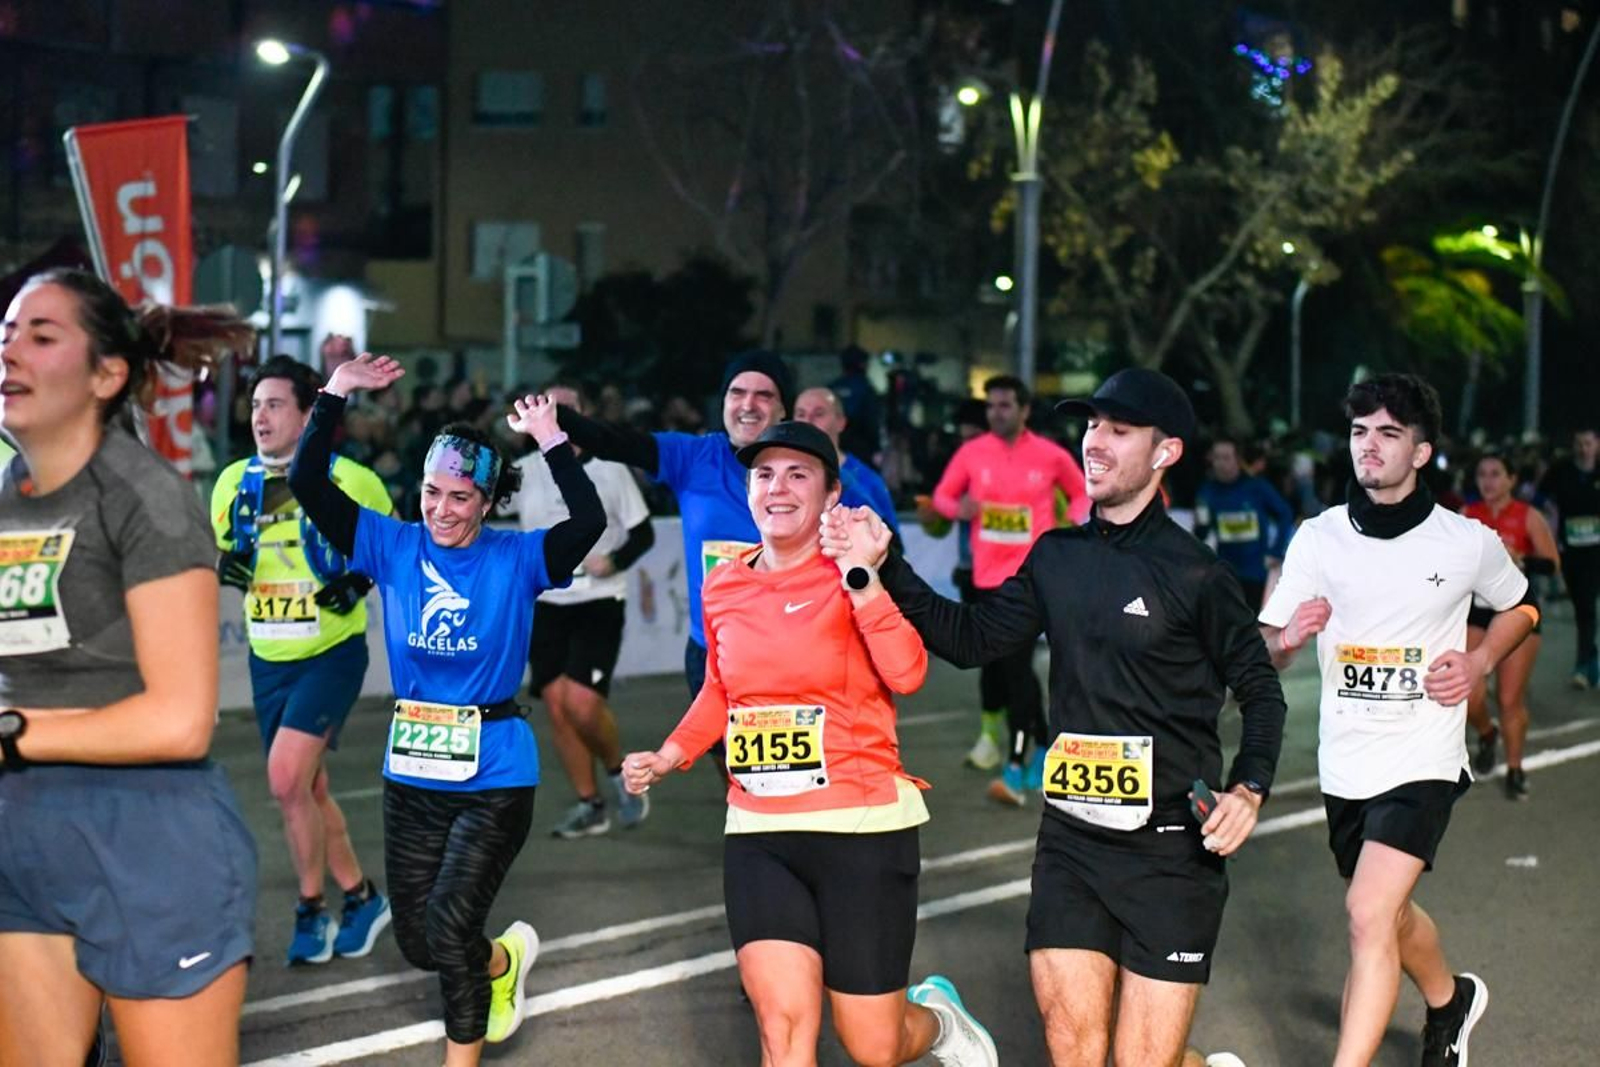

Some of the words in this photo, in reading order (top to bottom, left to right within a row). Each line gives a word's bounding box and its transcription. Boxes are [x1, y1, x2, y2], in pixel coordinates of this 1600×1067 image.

[253, 597, 307, 616] 3171
[407, 632, 478, 652] GACELAS
[1352, 648, 1366, 661] 42
[1343, 664, 1418, 691] 9478
[408, 705, 421, 719] 42
[742, 713, 757, 727] 42
[397, 721, 470, 754] 2225
[733, 730, 811, 763] 3155
[1064, 740, 1081, 756] 42
[1050, 761, 1140, 795] 4356
